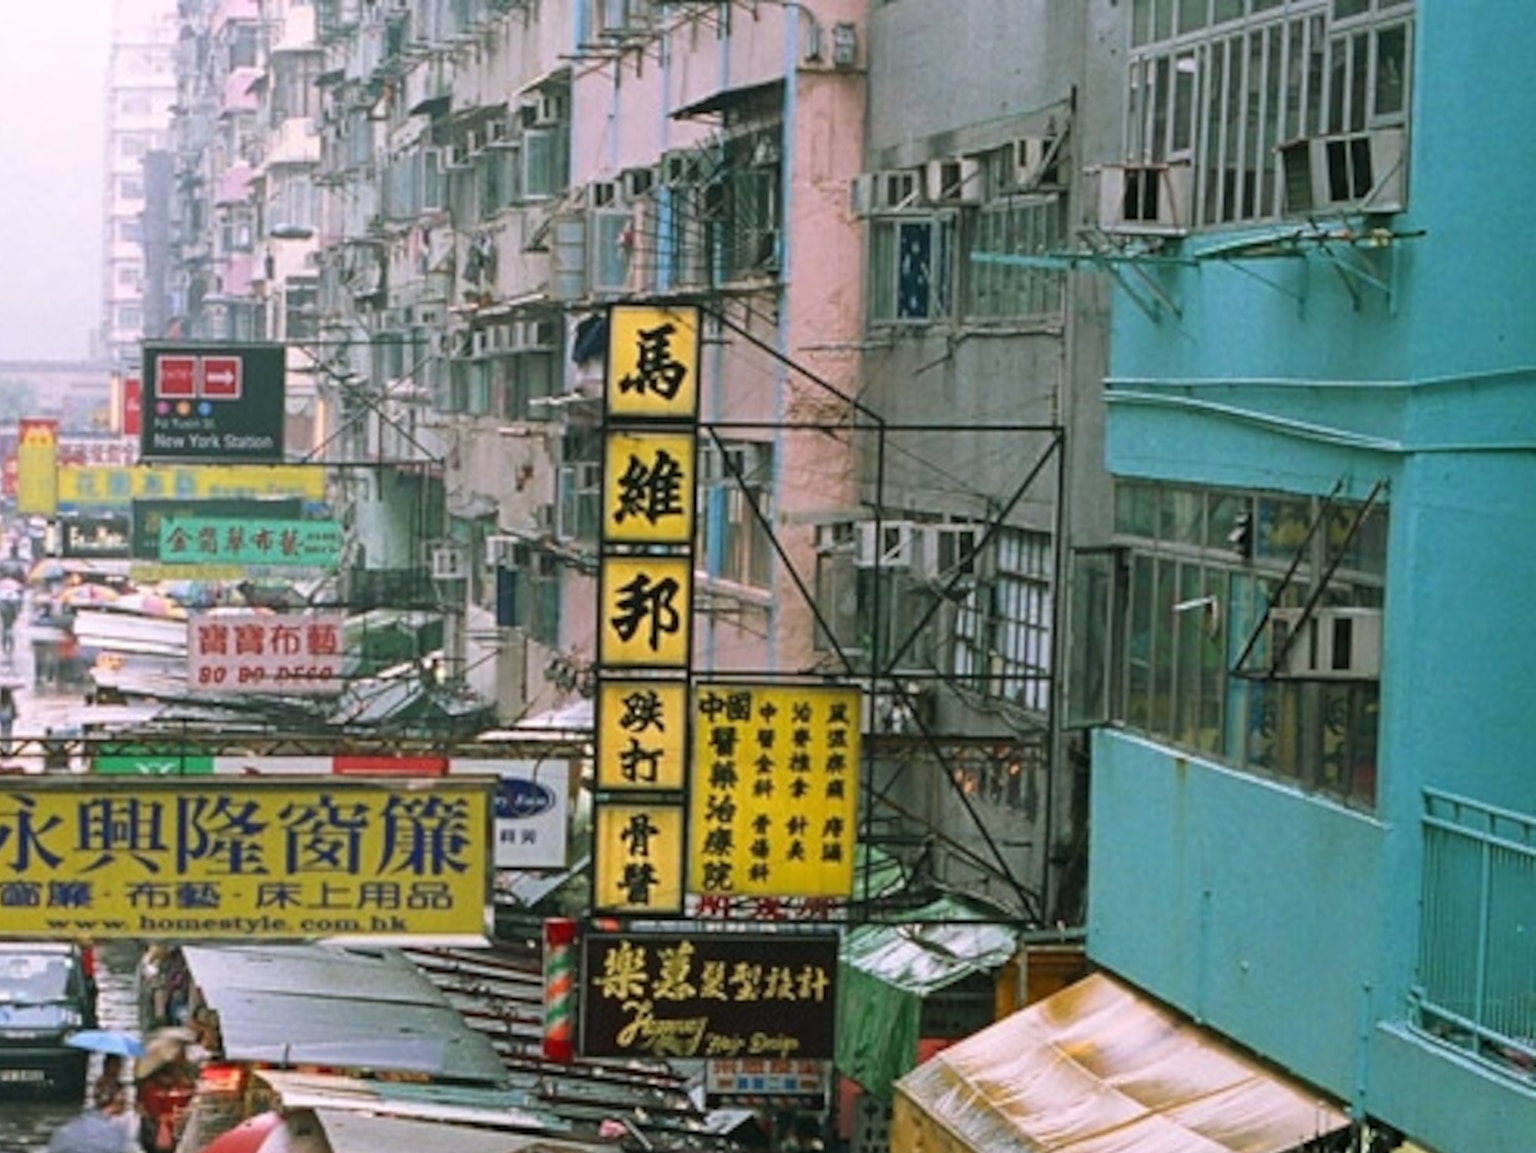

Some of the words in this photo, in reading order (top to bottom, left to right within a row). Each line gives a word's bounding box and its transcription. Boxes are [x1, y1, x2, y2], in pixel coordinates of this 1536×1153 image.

[154, 433, 184, 447] New
[188, 433, 220, 447] York
[223, 433, 273, 449] Station
